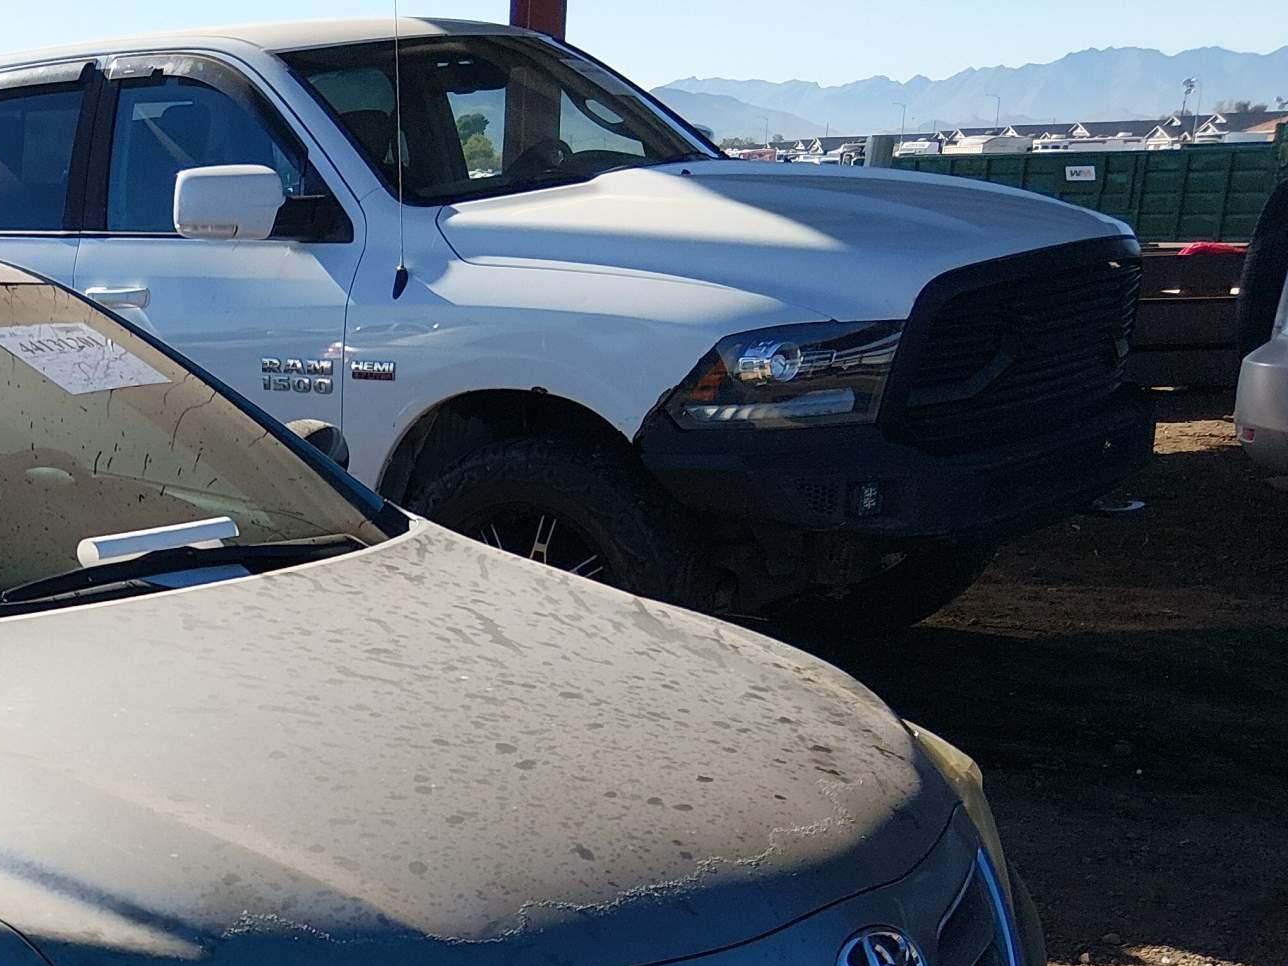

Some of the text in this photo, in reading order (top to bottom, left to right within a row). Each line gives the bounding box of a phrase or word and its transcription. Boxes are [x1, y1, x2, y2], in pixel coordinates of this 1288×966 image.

[18, 335, 105, 354] 44131201
[261, 357, 333, 376] RAM
[350, 361, 394, 373] HEMI
[262, 374, 333, 394] 1500
